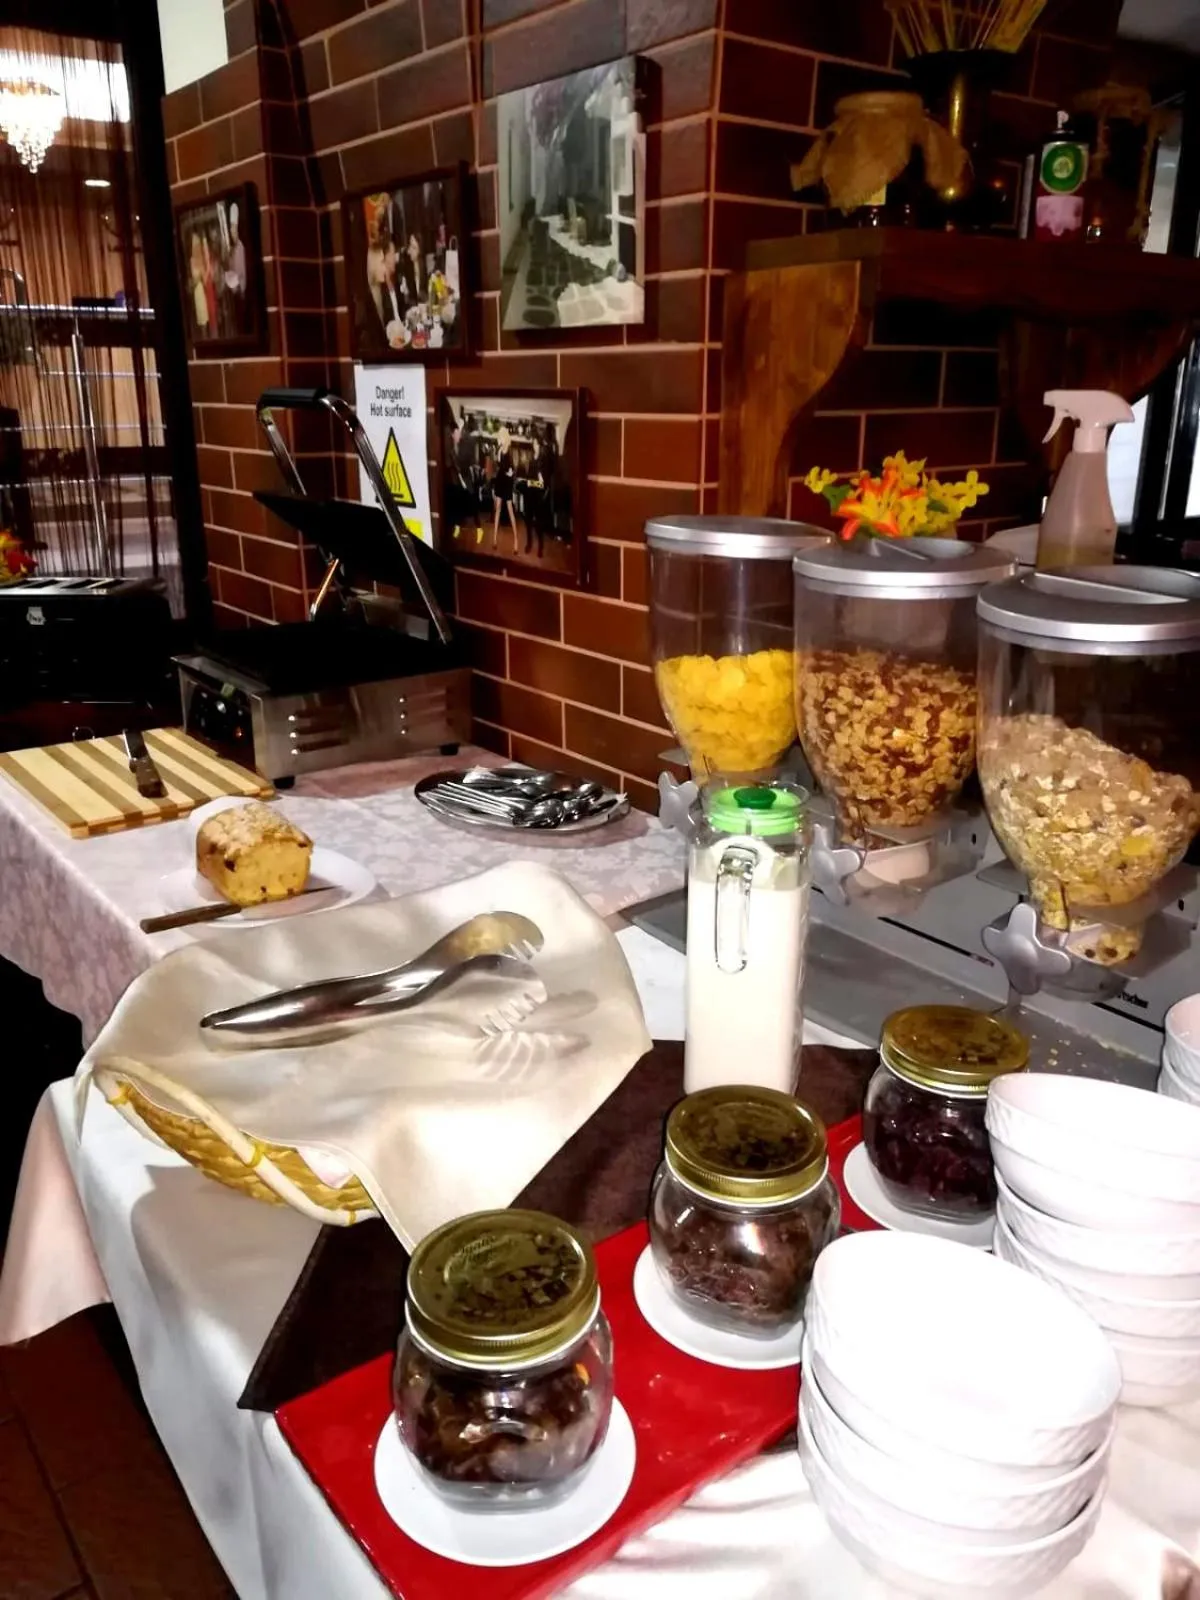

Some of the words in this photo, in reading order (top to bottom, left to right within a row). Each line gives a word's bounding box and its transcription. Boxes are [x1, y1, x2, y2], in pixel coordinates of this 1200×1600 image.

[375, 385, 405, 403] Danger!
[370, 402, 383, 417] Hot
[384, 403, 412, 418] surface
